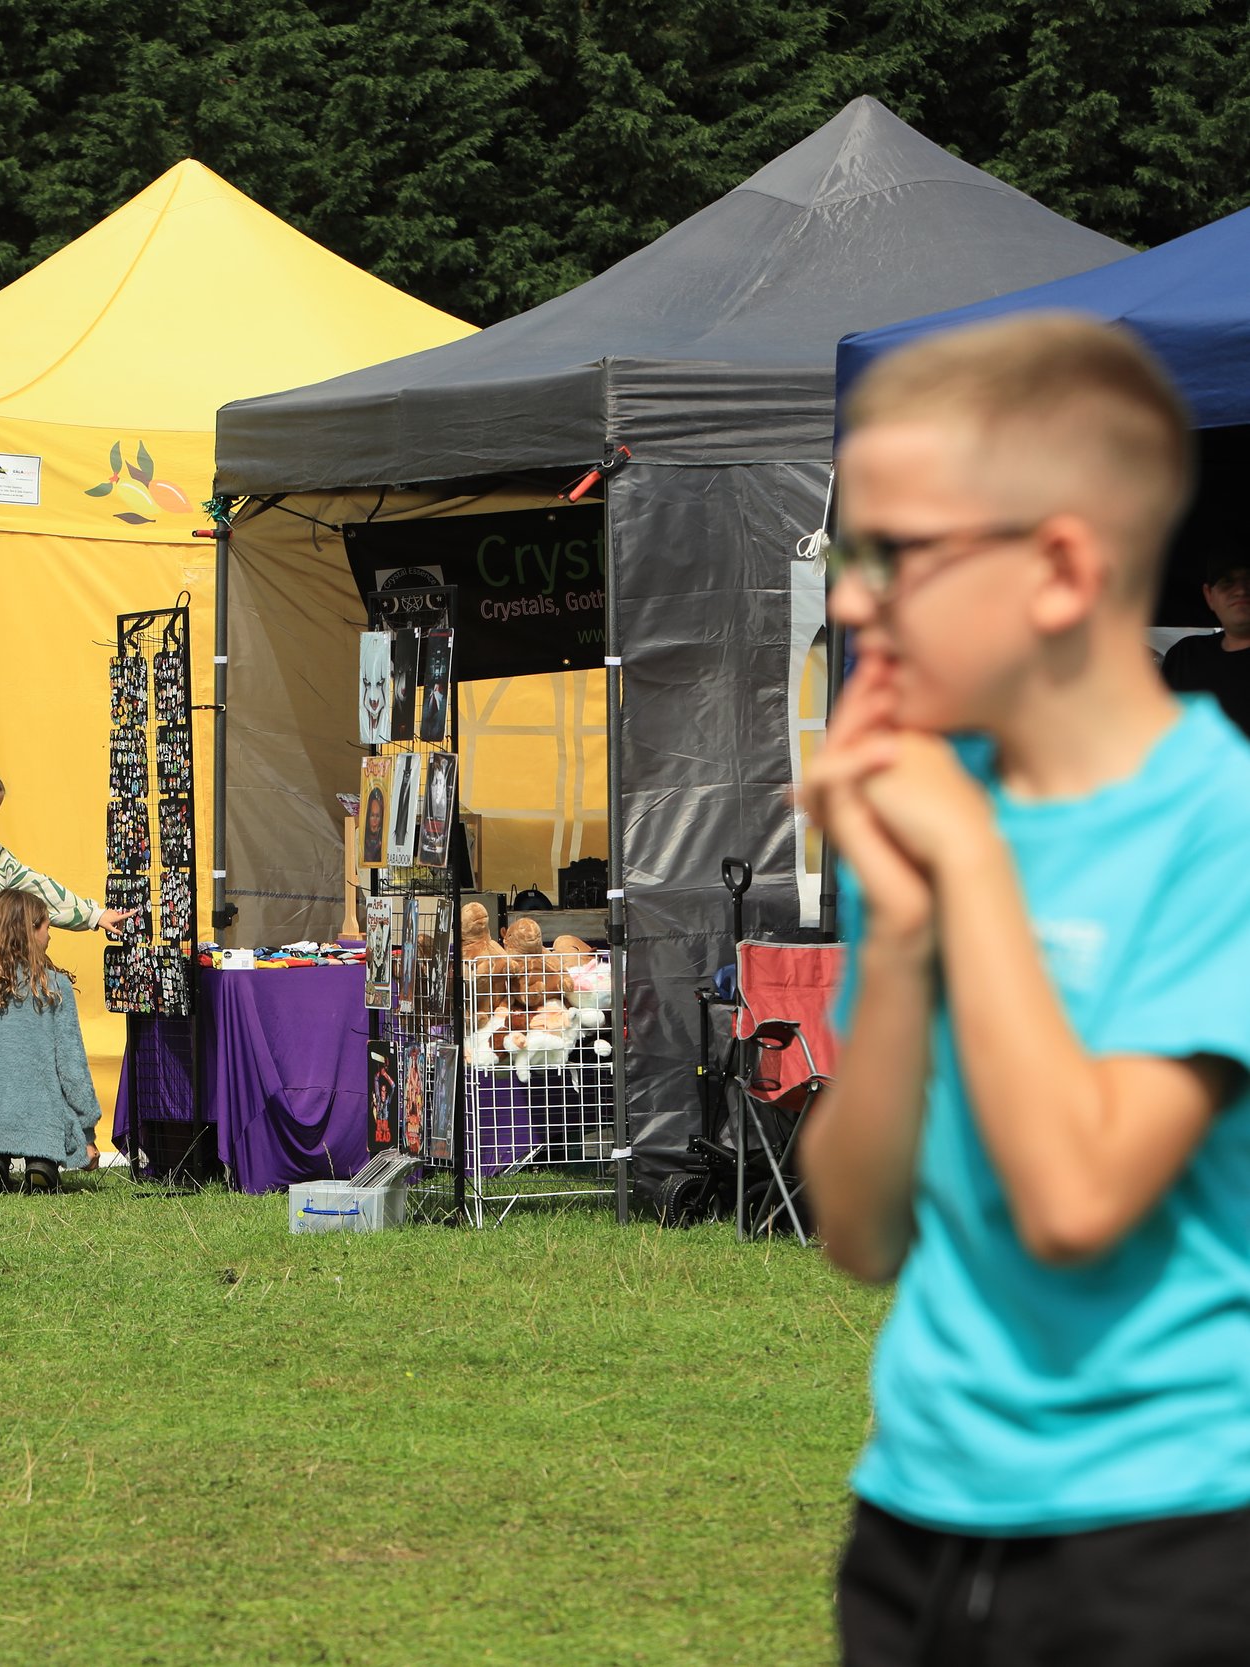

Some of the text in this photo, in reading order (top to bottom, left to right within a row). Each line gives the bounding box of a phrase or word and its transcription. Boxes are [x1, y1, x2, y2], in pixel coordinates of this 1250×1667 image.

[476, 529, 605, 595] Cryst
[384, 566, 437, 589] Crystal Essence
[480, 589, 605, 622] Crystals, Goth
[375, 1131, 391, 1142] DEAD
